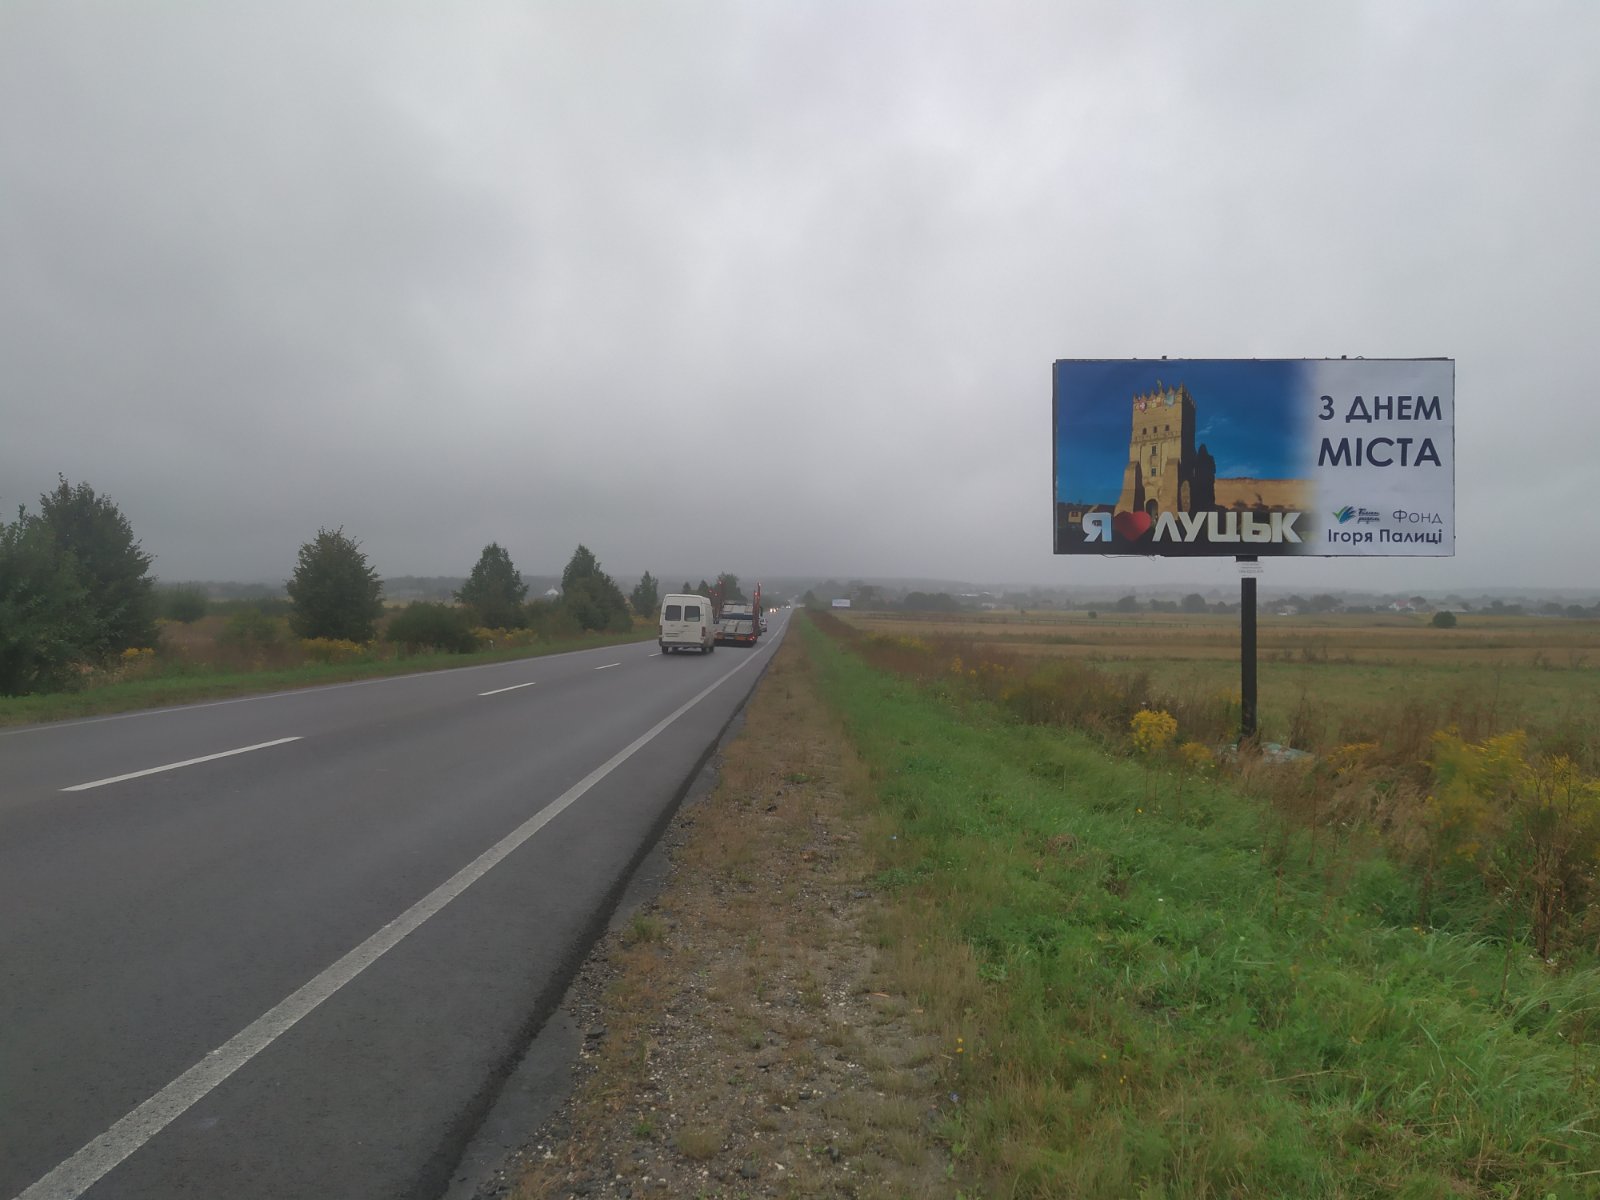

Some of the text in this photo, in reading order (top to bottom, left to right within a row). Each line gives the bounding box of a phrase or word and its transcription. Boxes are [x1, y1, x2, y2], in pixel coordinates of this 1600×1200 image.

[1318, 395, 1442, 423] З ДНЕМ
[1318, 437, 1442, 467] МІСТА
[1082, 511, 1304, 544] Я ЛУЦЬК
[1328, 529, 1442, 545] Ігоря Палиці
